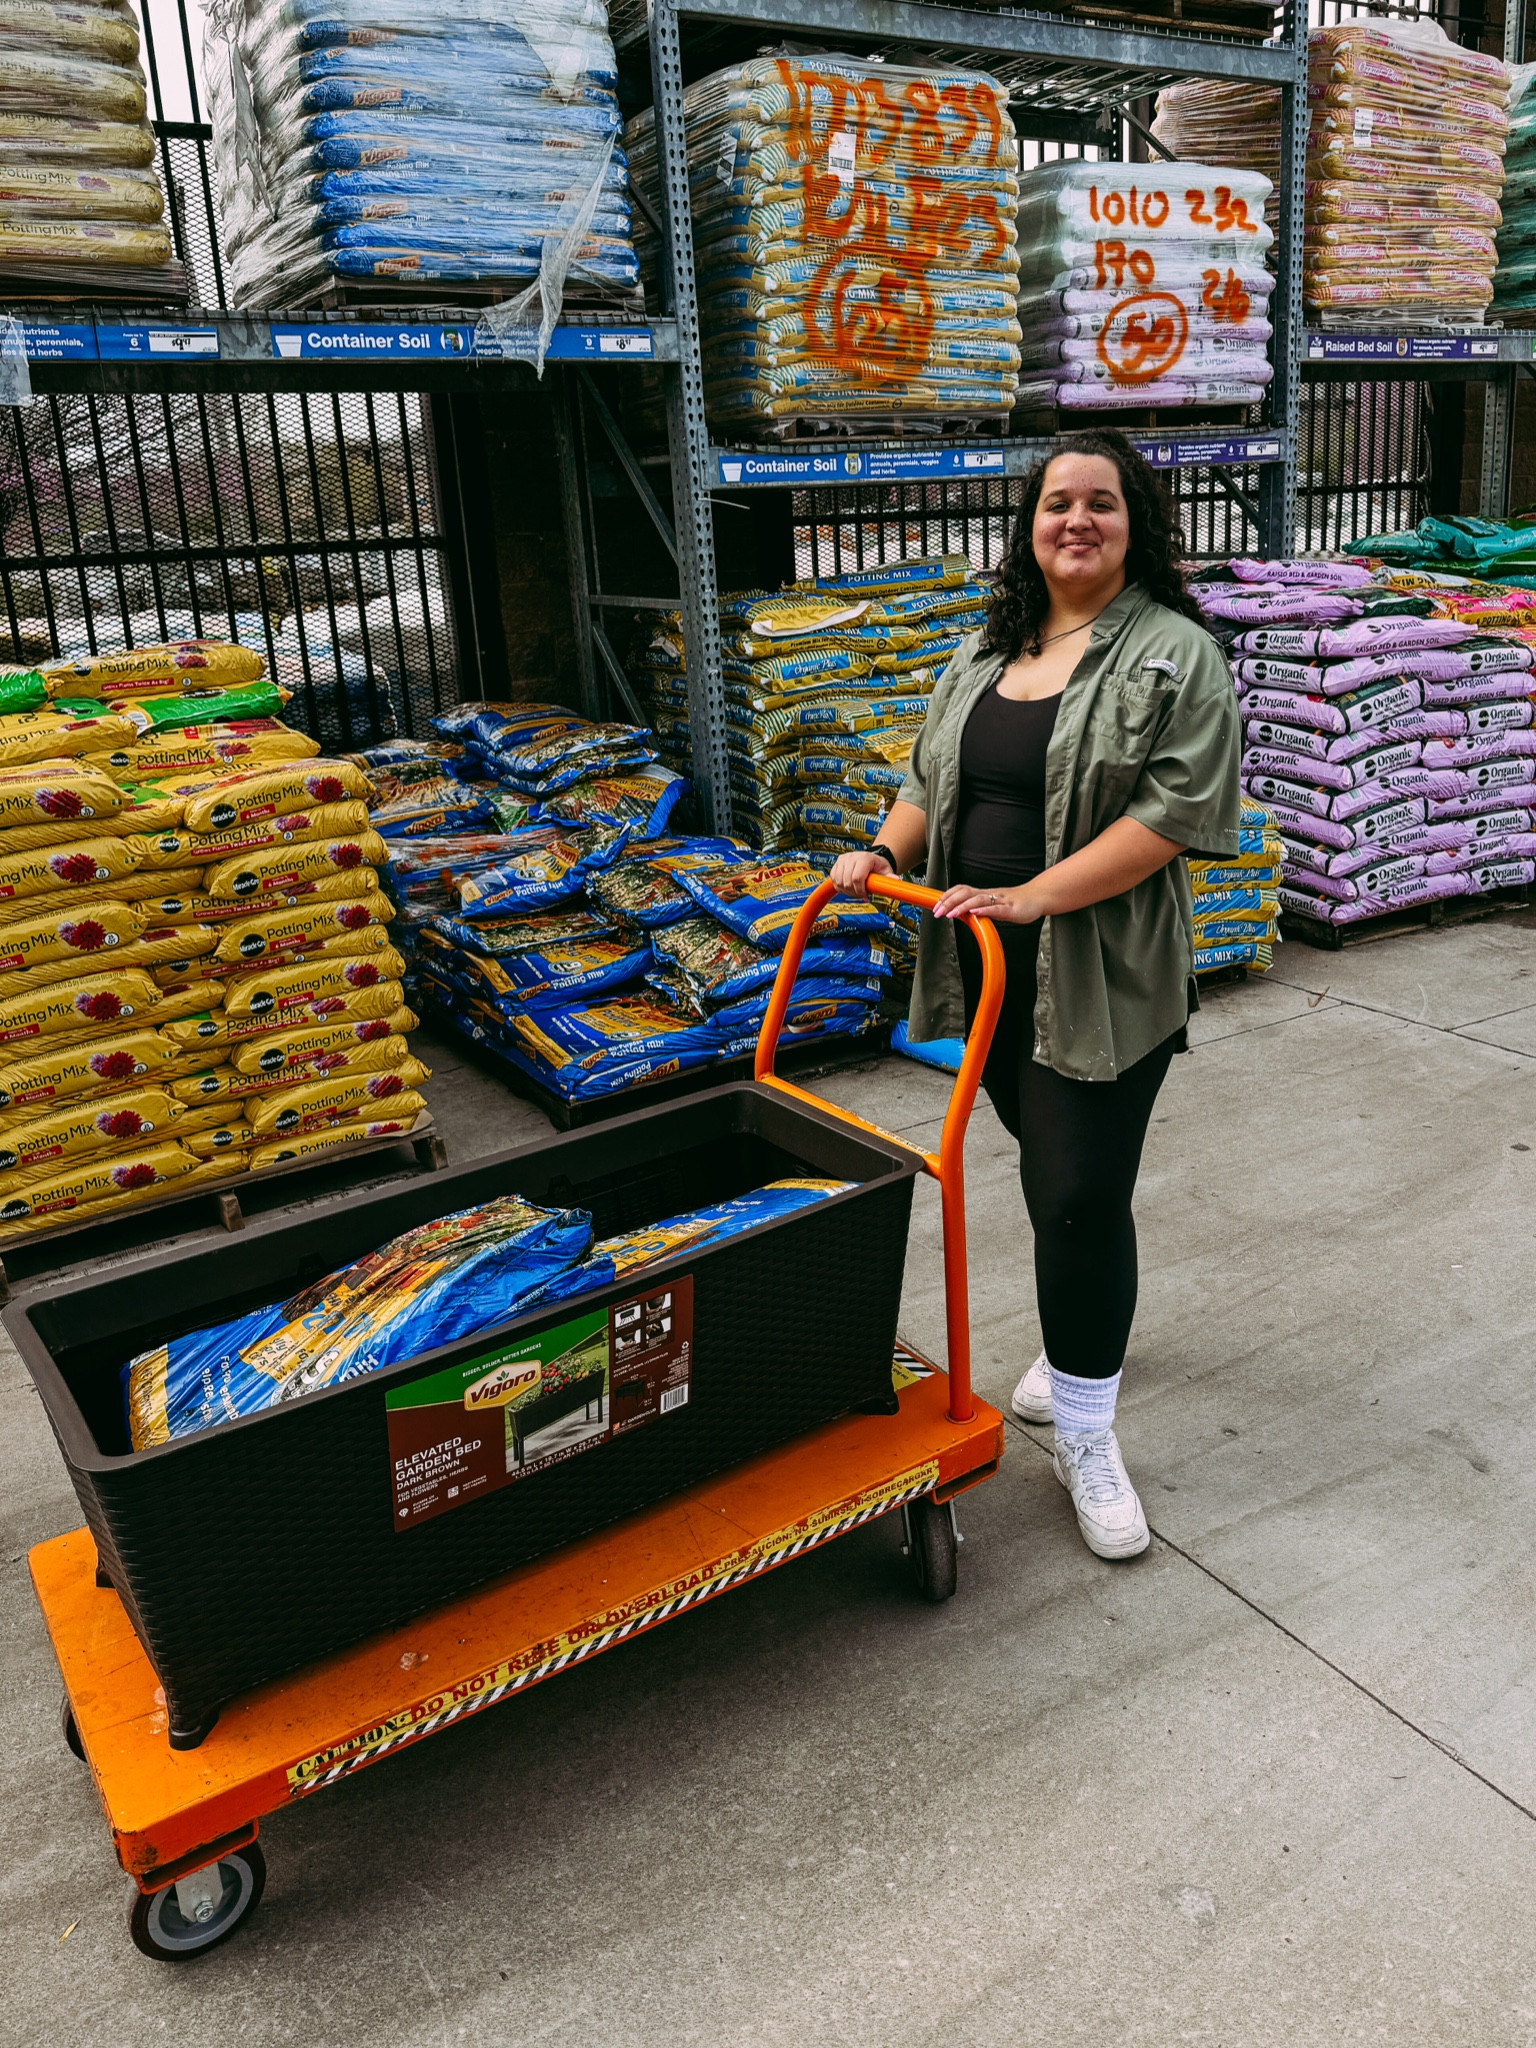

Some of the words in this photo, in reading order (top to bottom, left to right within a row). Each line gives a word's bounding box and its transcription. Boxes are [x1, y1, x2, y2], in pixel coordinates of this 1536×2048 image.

[356, 89, 399, 105] Vigoro
[49, 173, 72, 185] Mix
[1089, 186, 1169, 227] 1010
[1185, 187, 1257, 232] 232
[3, 223, 51, 235] Potting
[53, 225, 76, 236] Mix
[378, 258, 419, 274] Vigoro
[1095, 239, 1155, 289] 170
[856, 288, 876, 299] MIX
[36, 338, 83, 347] perennials,
[307, 332, 393, 348] Container
[399, 333, 430, 348] Soil
[1225, 339, 1257, 349] Organic
[1326, 341, 1355, 351] Raised
[1358, 342, 1375, 352] Bed
[1376, 342, 1392, 352] Soil
[1218, 384, 1252, 395] Organic
[746, 460, 809, 474] Container
[813, 459, 837, 472] Soil
[848, 573, 889, 583] POTTING
[893, 569, 912, 579] MIX
[1307, 572, 1329, 580] GARDEN
[1330, 573, 1342, 581] SOIL
[879, 587, 899, 595] Outdoor
[900, 584, 927, 593] Containers
[911, 595, 948, 609] POTTING
[950, 590, 967, 601] MIX
[1270, 632, 1306, 647] Organic
[1355, 643, 1377, 653] RAISED
[1378, 642, 1391, 650] BED
[1398, 639, 1425, 648] GARDEN
[821, 659, 837, 670] Plus
[1485, 651, 1520, 664] Organic
[100, 662, 145, 674] Potting
[146, 659, 169, 669] Mix
[1269, 664, 1308, 680] Organic
[1455, 675, 1494, 689] Organic
[1260, 696, 1297, 709] Organic
[1373, 688, 1410, 710] Organic
[1390, 713, 1426, 728] Organic
[1490, 705, 1523, 720] Organic
[534, 724, 567, 740] Vigoro
[1275, 729, 1314, 748] Organic
[138, 753, 186, 765] Potting
[187, 748, 211, 760] Mix
[1378, 747, 1413, 767] Organic
[1491, 763, 1525, 778] Organic
[1392, 772, 1429, 786] Organic
[237, 792, 281, 809] Potting
[282, 786, 304, 797] Mix
[1277, 784, 1315, 805] Organic
[1469, 789, 1502, 801] Organic
[7, 797, 32, 809] Mix
[407, 814, 443, 834] Vigoro
[1377, 806, 1413, 826] Organic
[1488, 814, 1523, 829] Organic
[189, 829, 242, 848] Potting
[245, 824, 269, 836] Mix
[1391, 829, 1429, 844] Organic
[21, 863, 48, 877] Mix
[260, 860, 305, 877] Potting
[306, 853, 327, 865] Mix
[1245, 868, 1259, 878] Plus
[1379, 861, 1415, 881] Organic
[1491, 866, 1525, 878] Organic
[751, 864, 808, 883] Vigoro
[515, 884, 548, 897] Potting
[1214, 891, 1231, 900] MIX
[1392, 879, 1428, 897] Organic
[1279, 892, 1318, 912] Organic
[267, 921, 312, 939] Potting
[313, 915, 334, 927] Mix
[1241, 923, 1256, 933] Plus
[31, 932, 58, 947] Mix
[1215, 951, 1233, 962] MIX
[276, 979, 321, 997] Potting
[322, 972, 343, 984] Mix
[521, 983, 549, 999] Vigoro
[553, 976, 586, 990] Potting
[47, 1003, 74, 1018] Mix
[227, 1013, 278, 1032] Potting
[280, 1004, 305, 1018] Mix
[793, 1006, 834, 1024] Vigoro
[287, 1036, 331, 1053] Potting
[332, 1029, 353, 1042] Mix
[580, 1050, 607, 1069] Vigoro
[11, 1071, 62, 1094] Potting
[63, 1064, 88, 1079] Mix
[302, 1094, 344, 1113] Potting
[345, 1085, 366, 1099] Mix
[18, 1131, 69, 1154] Potting
[70, 1124, 94, 1138] Mix
[345, 1130, 366, 1142] Mix
[32, 1183, 84, 1204] Potting
[85, 1176, 110, 1191] Mix
[463, 1368, 481, 1378] BIGGER,
[482, 1359, 502, 1369] BOLDER,
[502, 1352, 520, 1362] BETTER
[520, 1343, 542, 1354] GARDENS
[470, 1369, 536, 1404] Vigoro
[395, 1437, 462, 1470] ELEVATED
[396, 1451, 451, 1482] GARDEN
[455, 1439, 482, 1457] BED
[397, 1473, 423, 1491] DARK
[425, 1459, 460, 1480] BROWN
[398, 1490, 410, 1500] FOR
[410, 1475, 449, 1495] VEGETABLES,
[449, 1466, 469, 1476] HERBS
[398, 1494, 410, 1503] AND
[411, 1482, 439, 1498] FLOWERS
[295, 1715, 406, 1779] CAUTION:
[411, 1696, 444, 1723] DO
[452, 1670, 500, 1703] NOT
[567, 1618, 600, 1646] OR
[606, 1566, 716, 1628] OVERLOAD
[795, 1521, 811, 1536] NO
[812, 1502, 856, 1529] SUBIRSE
[865, 1466, 933, 1503] SOBRECARGAR
